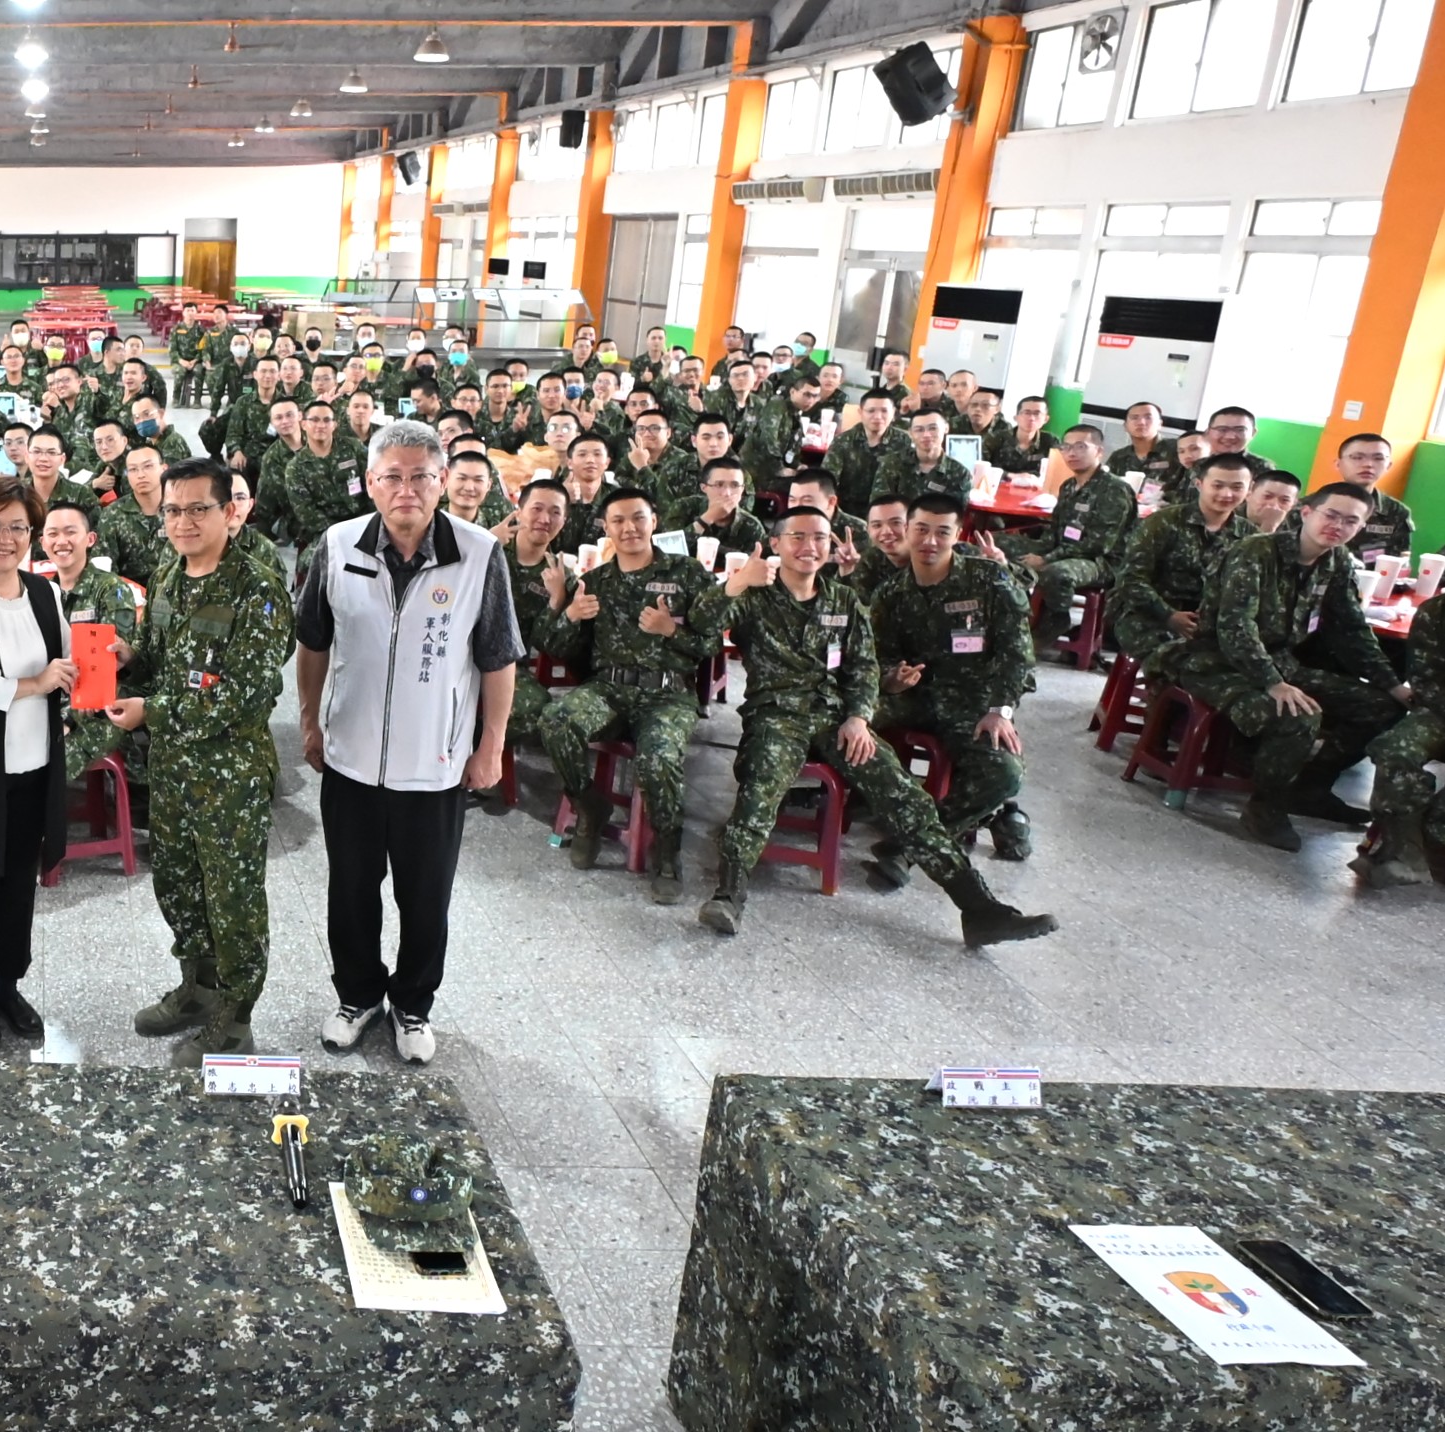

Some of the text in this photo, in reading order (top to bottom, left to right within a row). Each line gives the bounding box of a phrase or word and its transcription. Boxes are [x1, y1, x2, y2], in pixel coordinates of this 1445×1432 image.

[418, 617, 436, 683] 軍人服務站
[436, 613, 451, 658] 彰化縣
